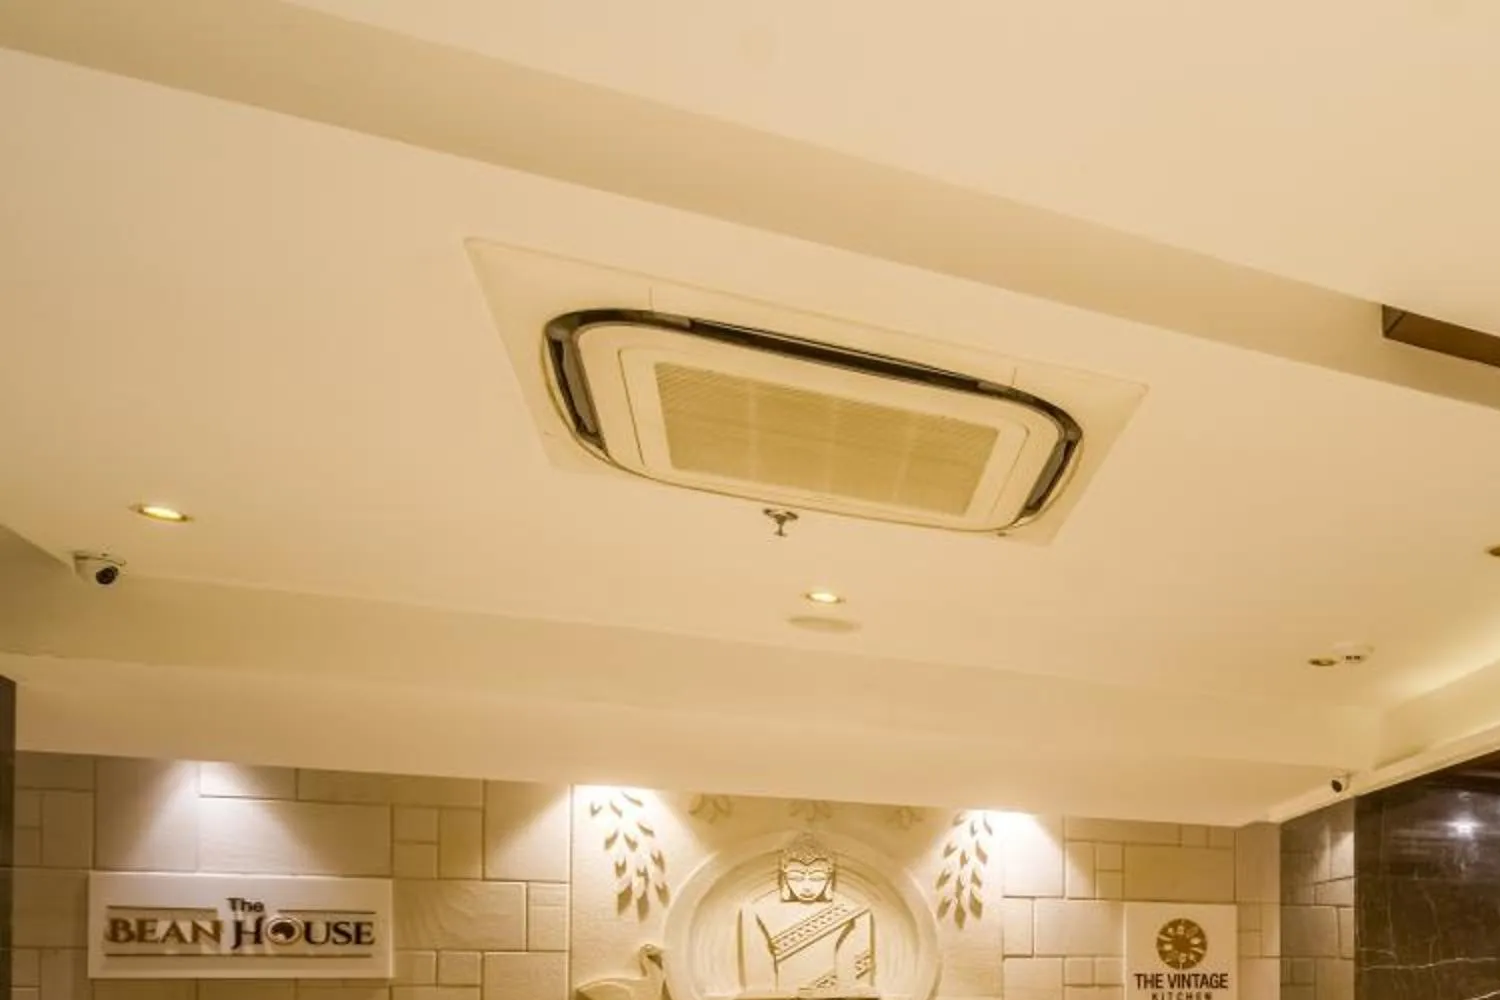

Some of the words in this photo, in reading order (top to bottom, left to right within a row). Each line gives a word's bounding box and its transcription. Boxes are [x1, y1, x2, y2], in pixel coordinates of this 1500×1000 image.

[226, 897, 264, 914] The
[105, 917, 223, 944] BEAN
[231, 916, 375, 949] HOUSE
[1134, 973, 1164, 989] THE
[1167, 973, 1229, 989] VINTAGE
